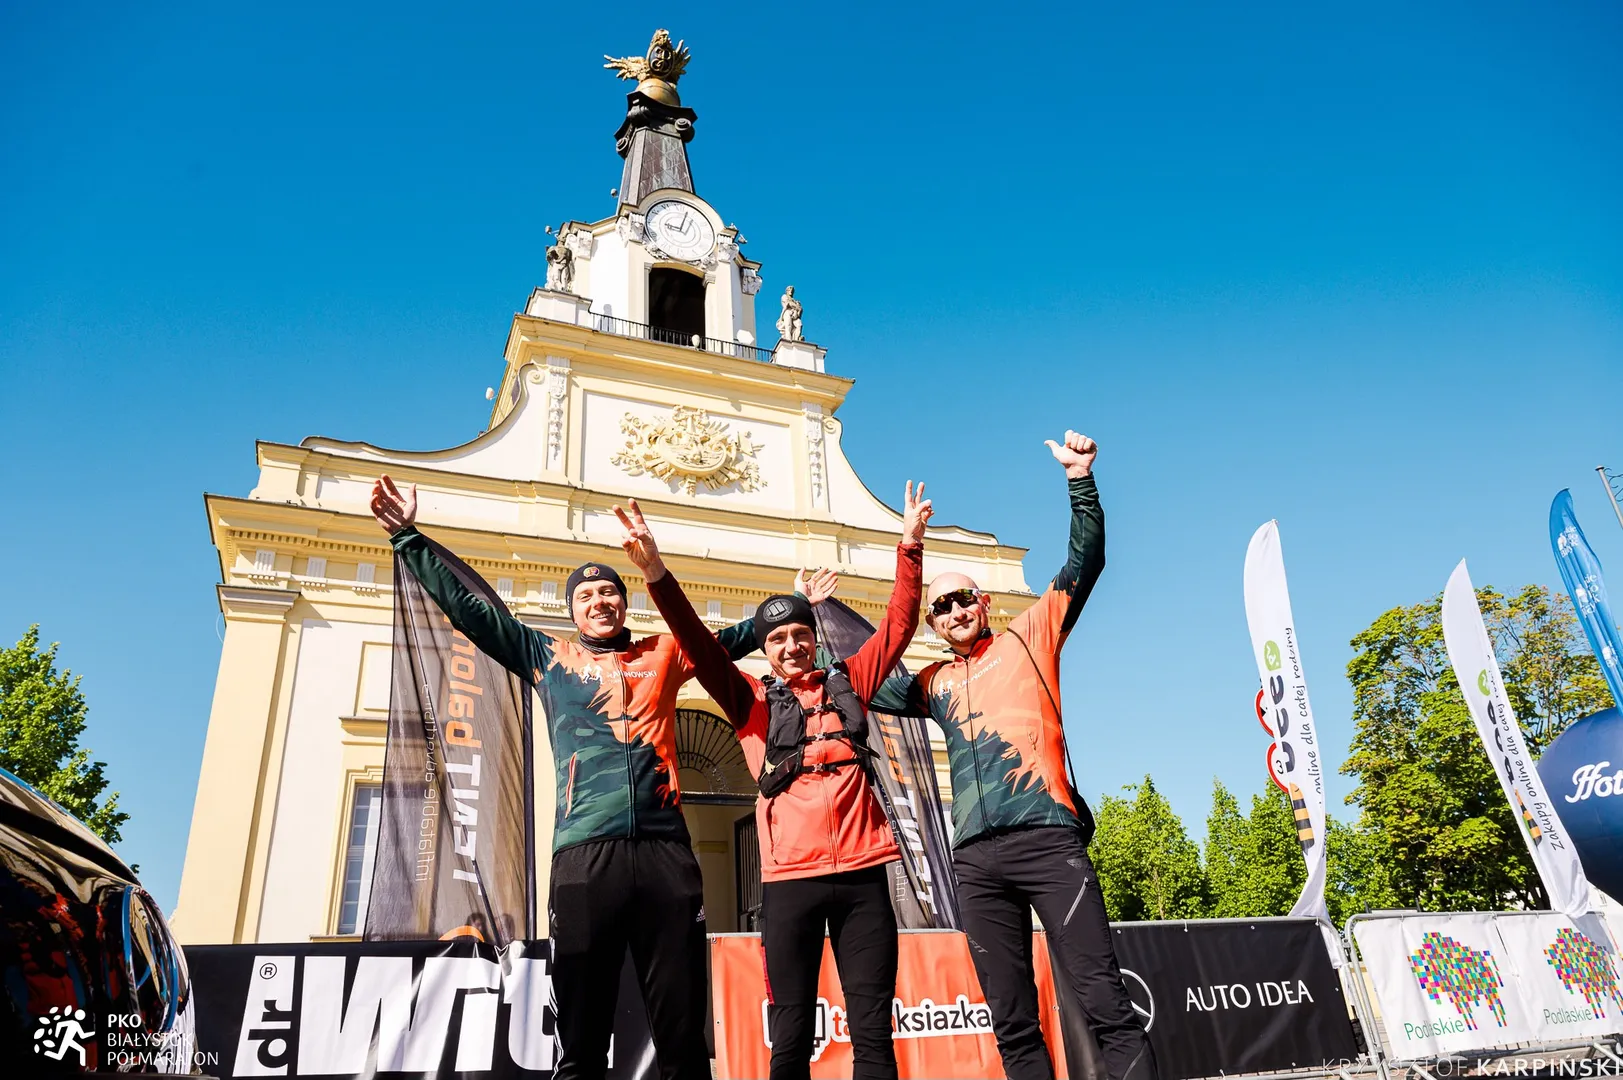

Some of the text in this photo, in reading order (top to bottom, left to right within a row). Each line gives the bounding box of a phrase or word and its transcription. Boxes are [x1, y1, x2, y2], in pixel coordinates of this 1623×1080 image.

[1285, 627, 1301, 679] rodziny
[1300, 722, 1313, 745] dla
[1507, 735, 1519, 755] dla
[1515, 760, 1537, 797] online
[1534, 802, 1565, 851] Zakupy
[1186, 979, 1314, 1012] AUTO IDEA
[1403, 1017, 1466, 1041] Podskie
[1543, 1006, 1594, 1025] Podlaskie
[247, 999, 292, 1069] dr
